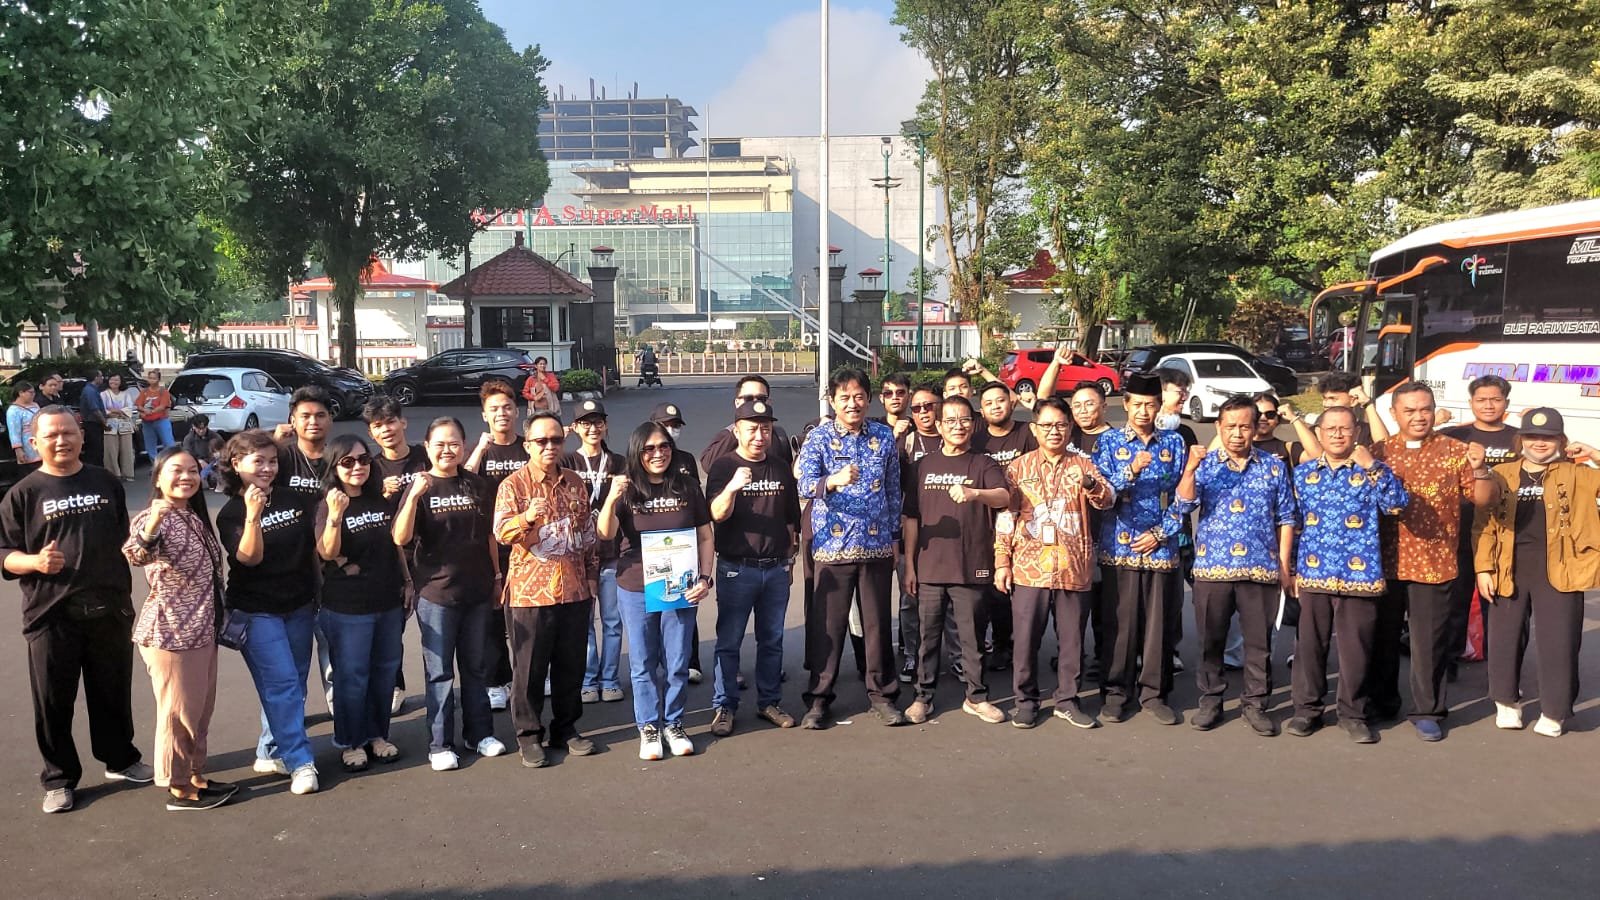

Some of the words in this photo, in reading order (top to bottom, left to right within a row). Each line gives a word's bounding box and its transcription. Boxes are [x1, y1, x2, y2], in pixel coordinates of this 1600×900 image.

[1503, 322, 1528, 335] BUS
[1528, 320, 1600, 335] PARIWISATA
[485, 459, 528, 471] Better
[924, 472, 968, 485] Better
[42, 493, 101, 515] Better
[345, 510, 385, 530] Better
